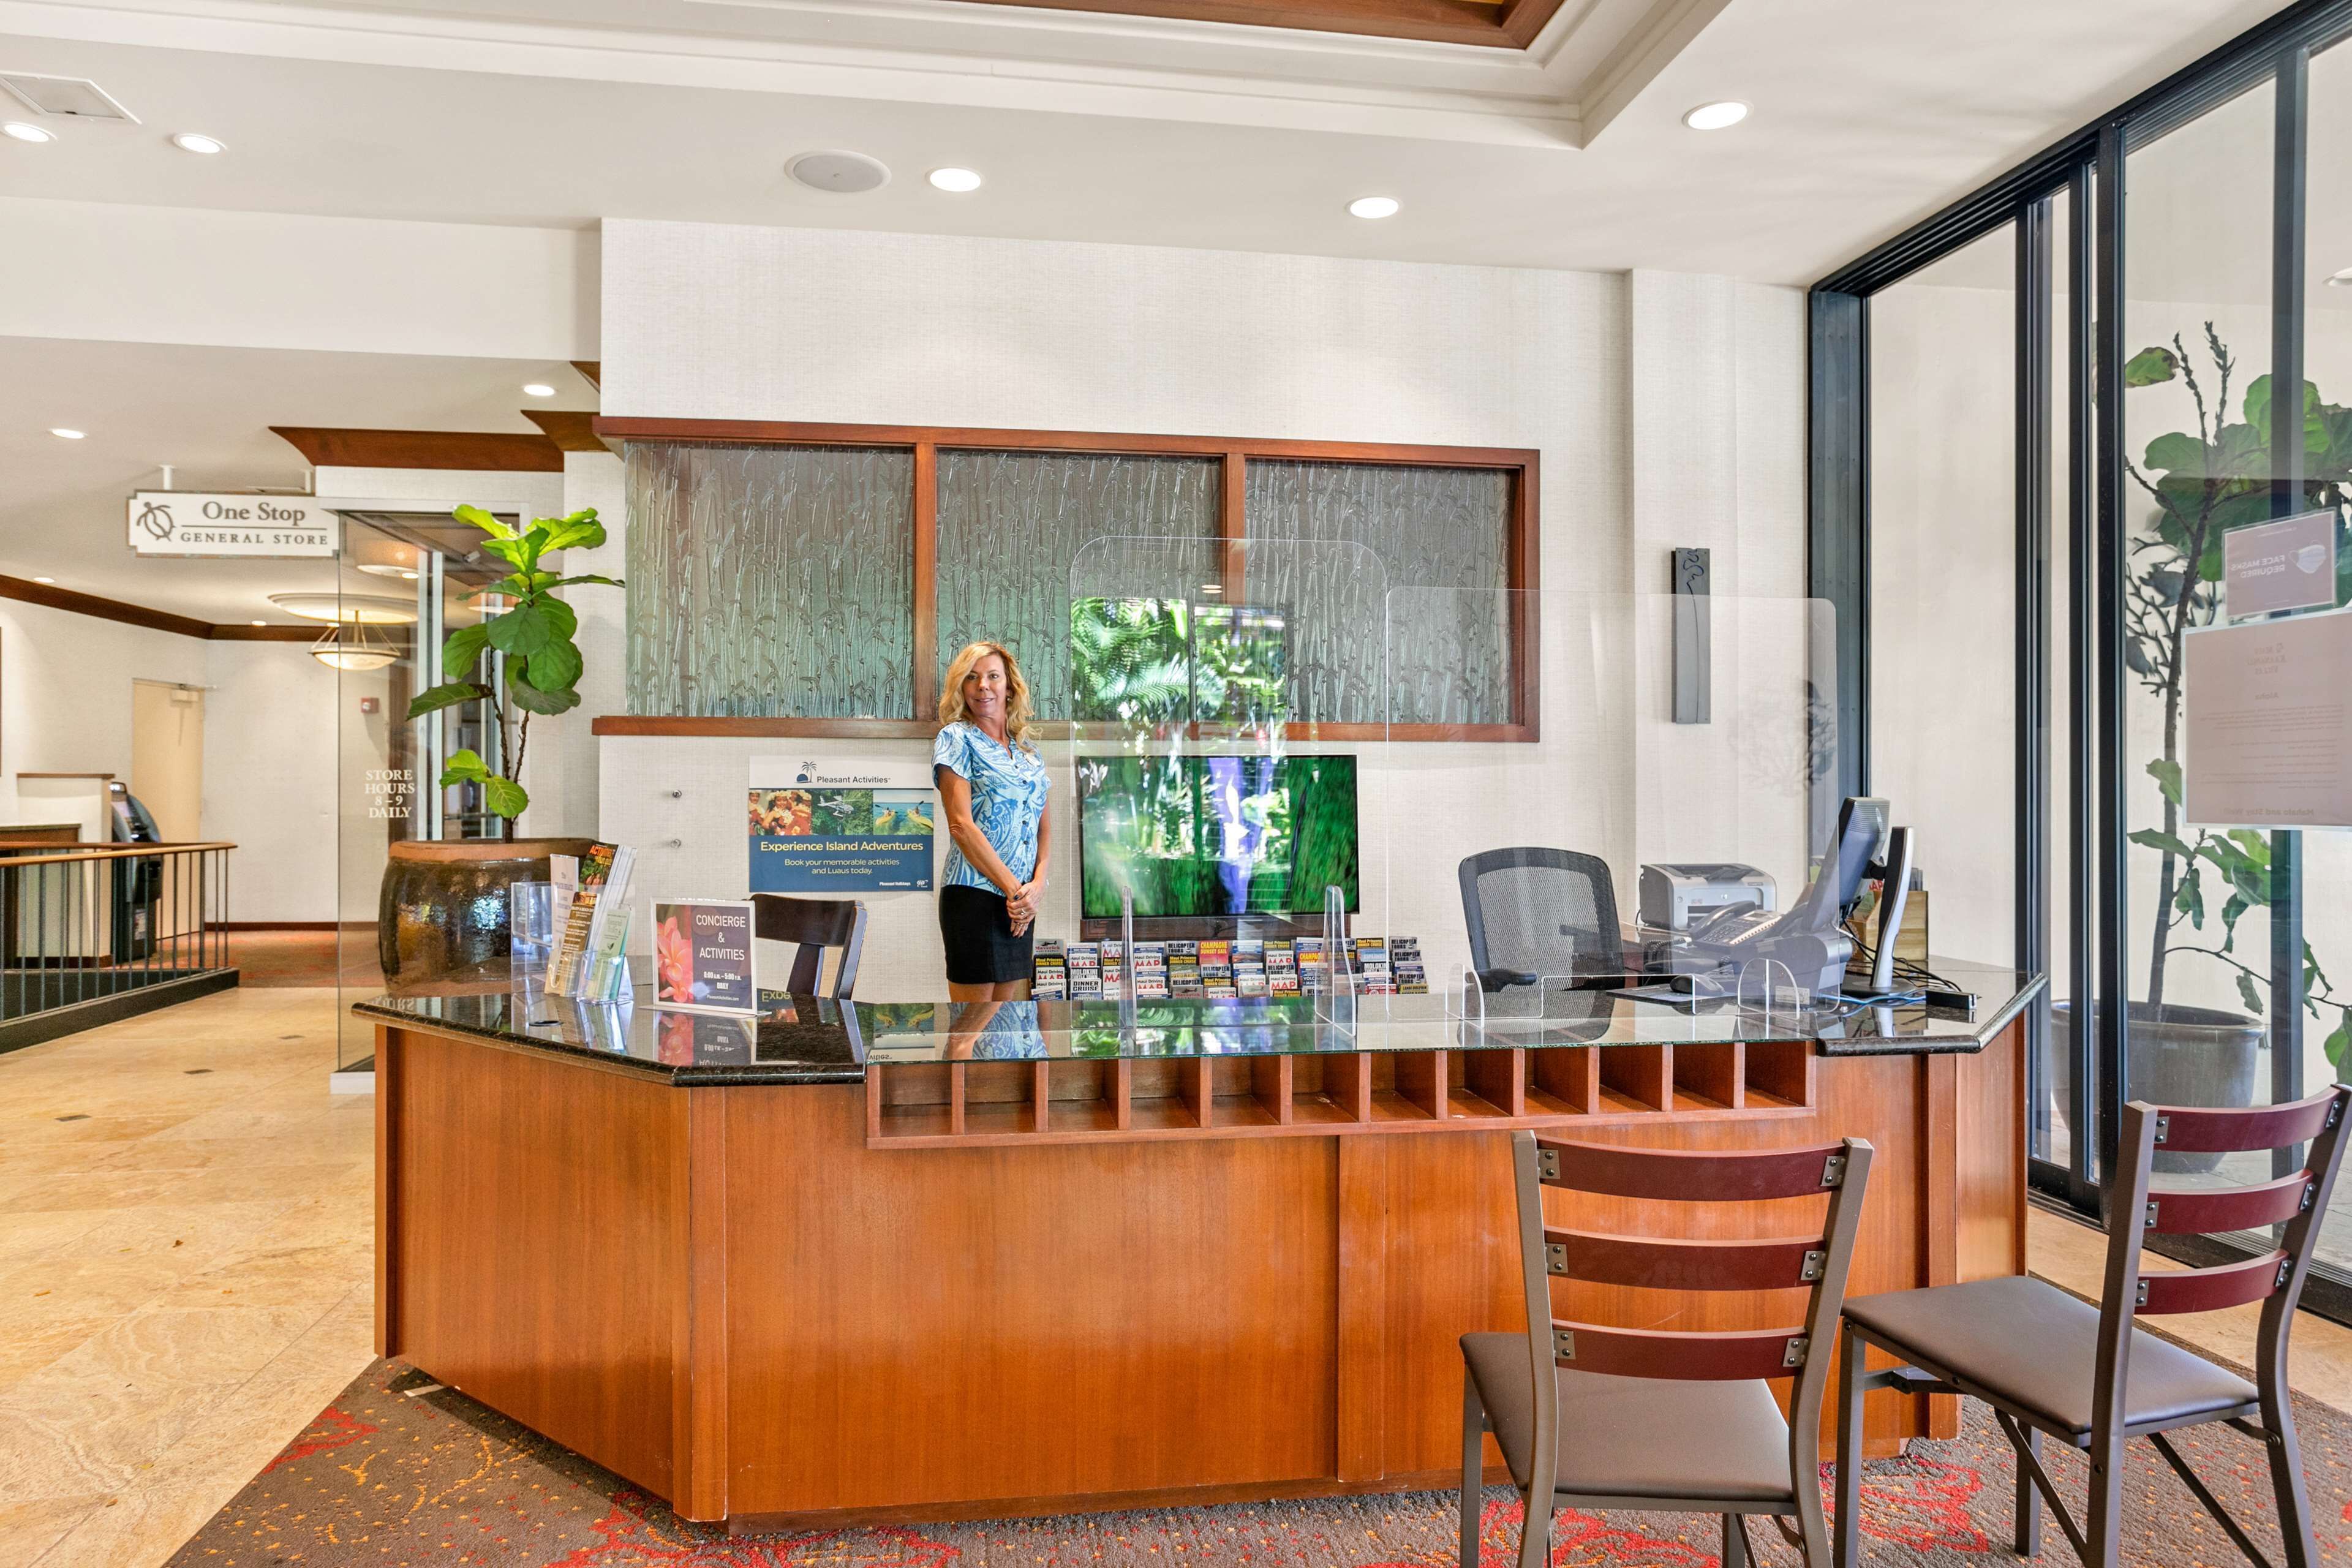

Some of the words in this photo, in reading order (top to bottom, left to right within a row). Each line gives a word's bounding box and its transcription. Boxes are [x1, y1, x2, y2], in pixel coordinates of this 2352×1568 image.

[203, 501, 251, 520] One
[258, 502, 306, 526] Stop
[181, 532, 265, 544] GENERAL
[273, 534, 328, 545] STORE
[366, 769, 413, 780] STORE
[364, 783, 415, 794] HOURS
[375, 796, 382, 805] 8
[396, 795, 404, 805] 9
[368, 807, 412, 818] DAILY
[761, 842, 823, 852] Experience
[826, 842, 858, 851] Island
[861, 842, 923, 851] Adventures
[696, 914, 746, 927] CONCIERGE
[718, 932, 725, 943] &
[699, 948, 745, 960] ACTIVITIES
[1271, 981, 1296, 990] MAP
